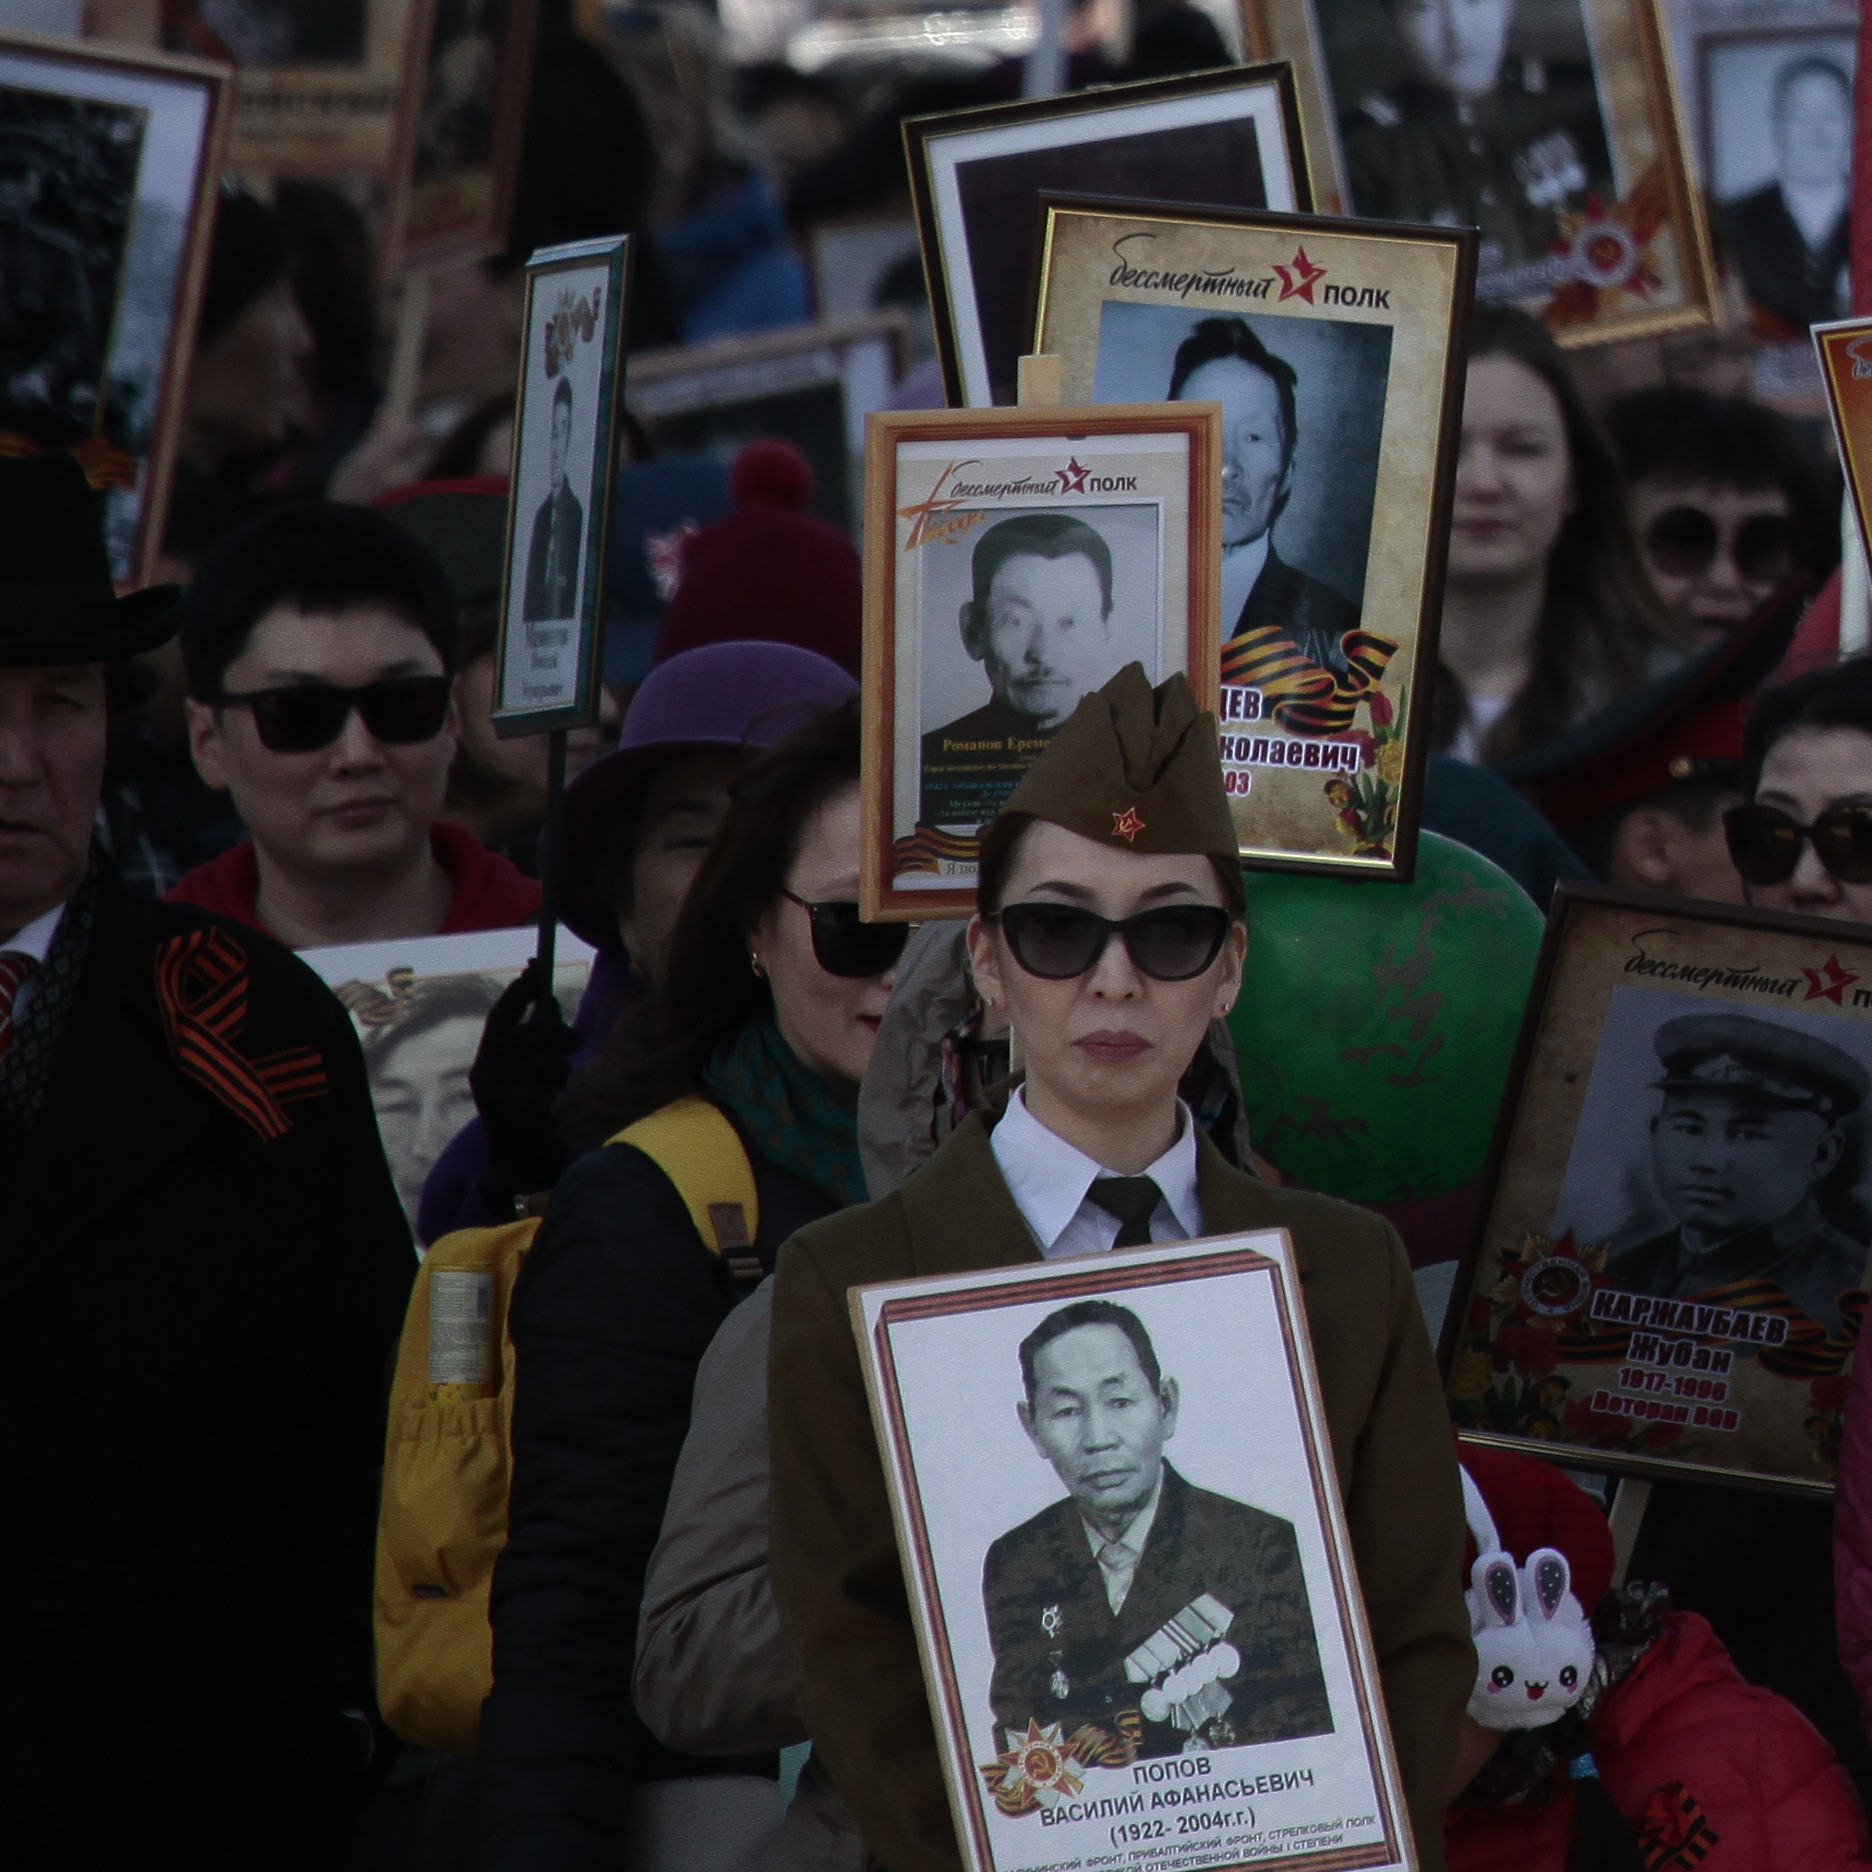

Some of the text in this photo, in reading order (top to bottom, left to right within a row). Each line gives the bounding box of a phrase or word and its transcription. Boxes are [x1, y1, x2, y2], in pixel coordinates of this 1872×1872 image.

[1109, 232, 1390, 309] бессмертный ПОЛК
[951, 460, 1137, 499] бессмертный ПОЛК
[943, 739, 1002, 752] Романов
[1624, 929, 1803, 998] бессмертный
[1592, 1290, 1788, 1345] КАРЖАУБАЕВ
[1627, 1333, 1733, 1373] Жубан
[1620, 1368, 1727, 1402] 1917-1996
[1592, 1390, 1739, 1429] Ветеран ВОВ
[1131, 1756, 1213, 1786] ПОПОВ
[1039, 1768, 1316, 1827] ВАСИЛИЙ АФАНАСЬЕВИЧ
[1085, 1853, 1126, 1868] ФРОНТ,
[1128, 1838, 1222, 1862] ПРИБАЛТИЙСКИЙ
[1225, 1831, 1266, 1848] ФРОНТ,
[1268, 1820, 1344, 1841] СТРЕЛКОВЫЙ
[1346, 1815, 1377, 1828] ПОЛК
[1109, 1805, 1257, 1848] (1922- 2004г.г.)
[1145, 1849, 1240, 1872] ОТЕЧЕСТВЕННОЙ
[1243, 1841, 1284, 1860] ВОЙНЫ
[1293, 1833, 1343, 1849] СТЕПЕНИ
